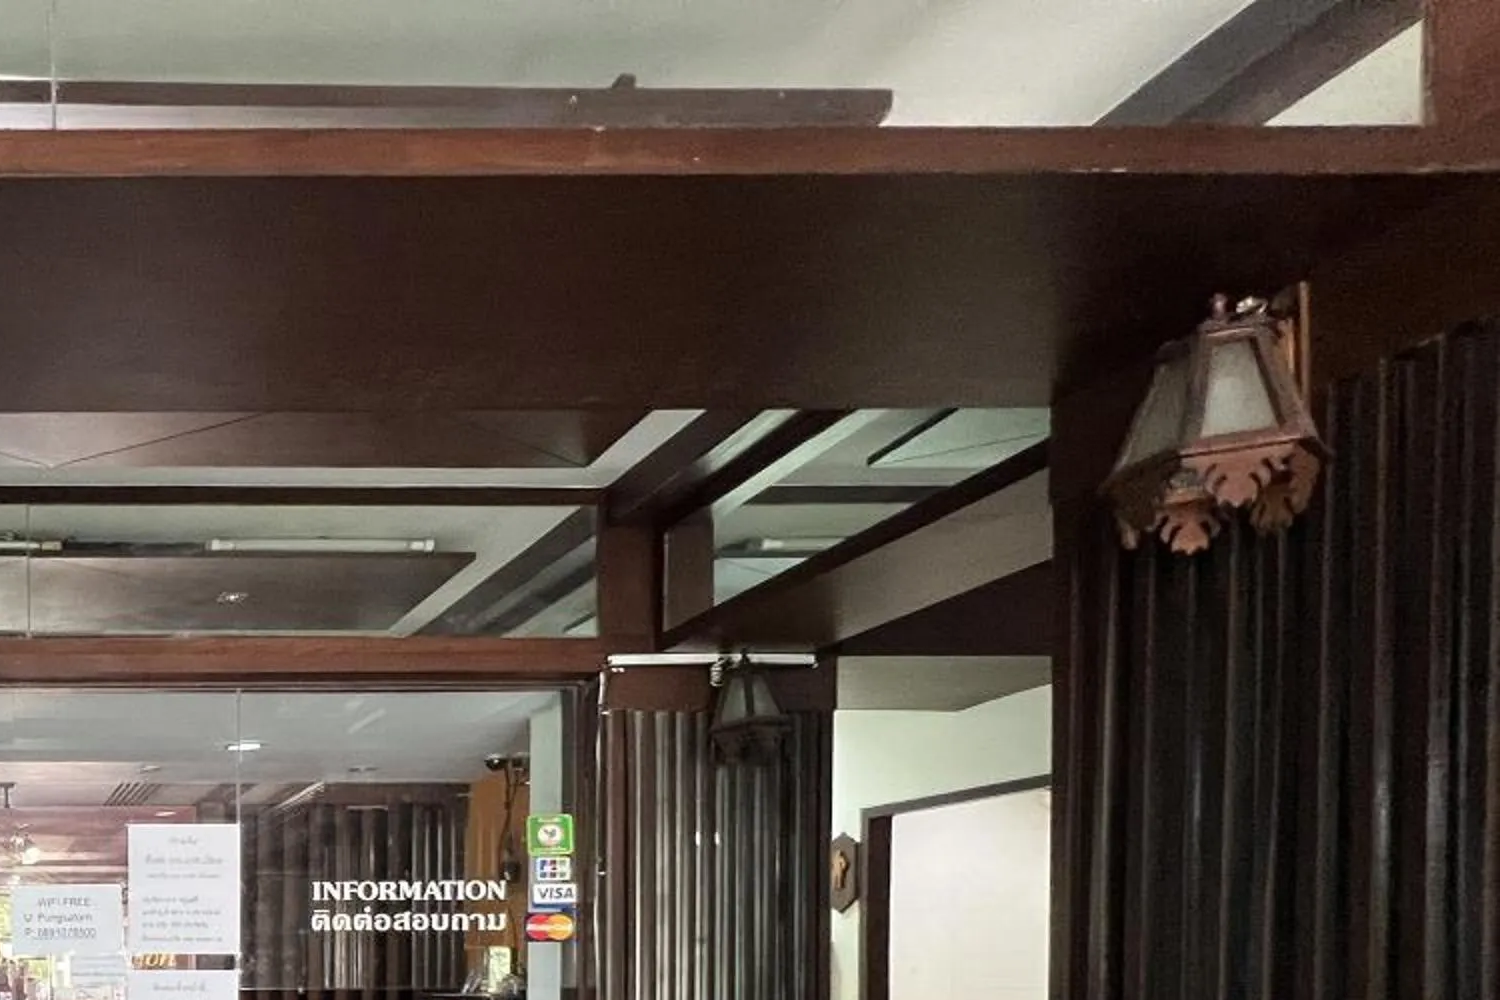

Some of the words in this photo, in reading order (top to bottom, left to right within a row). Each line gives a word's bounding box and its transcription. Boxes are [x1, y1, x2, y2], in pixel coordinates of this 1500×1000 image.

[311, 880, 507, 901] INFORMATION
[537, 887, 575, 899] VISA
[311, 906, 507, 931] ติดต่อสอบถาม
